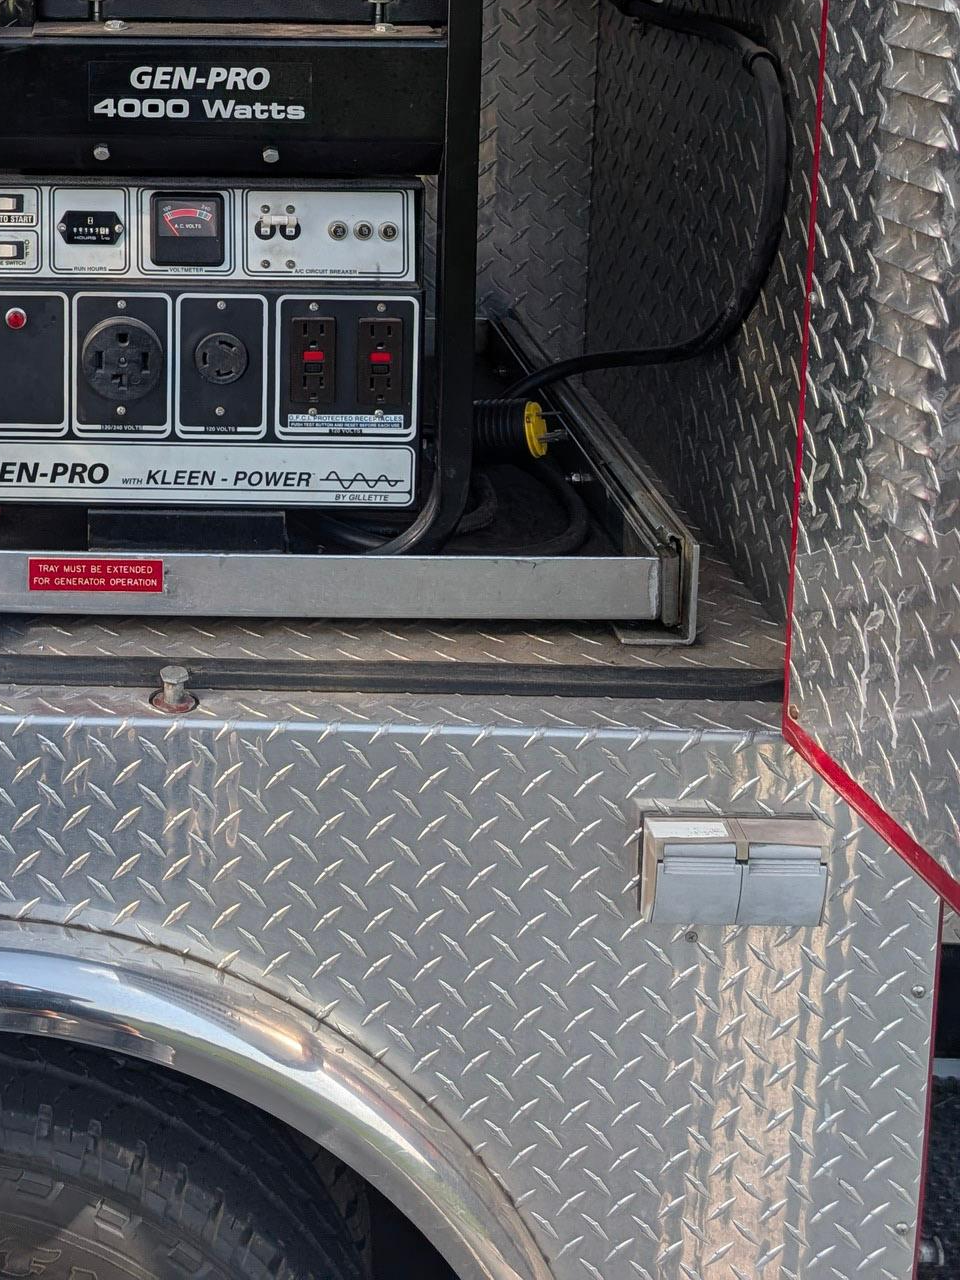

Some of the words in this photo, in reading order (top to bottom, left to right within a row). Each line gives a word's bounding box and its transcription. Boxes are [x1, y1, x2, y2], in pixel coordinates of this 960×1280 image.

[130, 66, 271, 91] GEN-PRO
[93, 98, 189, 118] 4000
[202, 99, 306, 120] Watts
[0, 215, 9, 223] TO
[122, 477, 143, 485] WITH
[145, 469, 216, 486] KLEEN
[233, 470, 312, 488] POWER
[334, 493, 347, 501] BY
[348, 494, 389, 502] GILLETTE
[38, 564, 59, 573] TRAY
[63, 565, 86, 573] MUST
[90, 565, 102, 573] BE
[106, 565, 153, 574] EXTENDED
[33, 576, 50, 585] FOR
[54, 577, 106, 586] GENERATOR
[109, 577, 157, 587] OPERATION
